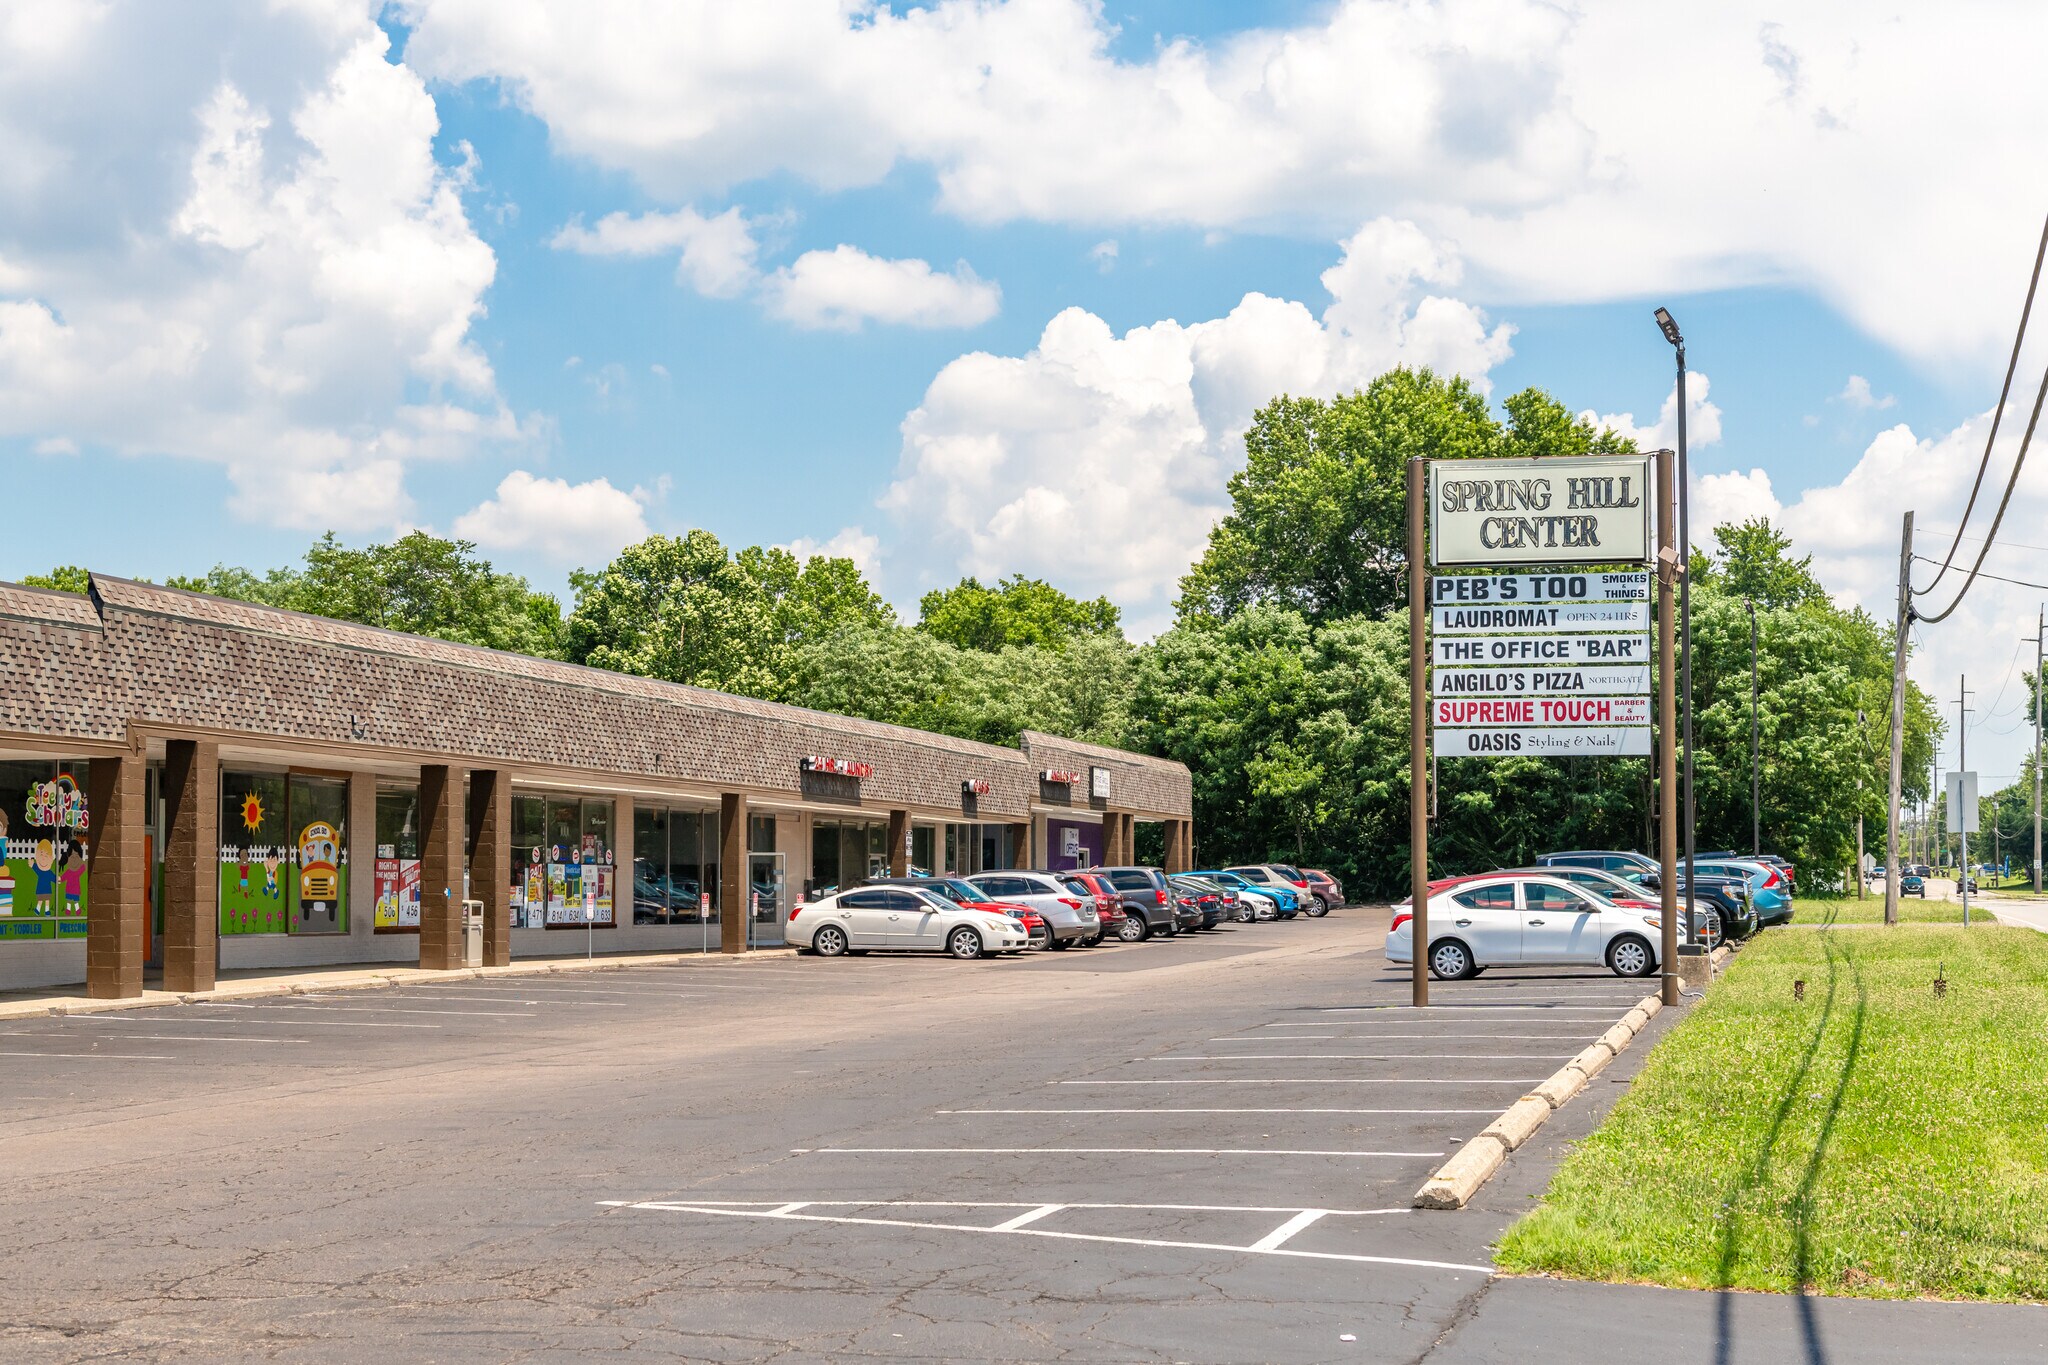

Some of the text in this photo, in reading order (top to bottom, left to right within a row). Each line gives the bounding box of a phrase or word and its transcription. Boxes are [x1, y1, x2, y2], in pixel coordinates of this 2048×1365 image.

[1442, 476, 1640, 513] SPRING HILL
[1479, 514, 1601, 550] CENTER
[1436, 576, 1587, 601] PEB'S TOO
[1601, 574, 1647, 584] SMOKES
[1604, 589, 1645, 599] THINGS
[1444, 608, 1638, 628] LAUDROMAT OPEN 24 HRS
[1440, 638, 1642, 660] THE OFFICE "BAR"
[1441, 672, 1644, 692] ANGILO'S PIZZA NORTHGATE
[1439, 700, 1611, 723] SUPREME TOUCH
[1468, 732, 1616, 752] OASIS Styling & Nails
[25, 796, 89, 828] Scholars
[376, 871, 384, 879] THE
[383, 871, 399, 881] MONEY
[378, 861, 392, 871] RIGHT
[406, 905, 418, 917] 456
[13, 923, 42, 935] TODDLER
[60, 922, 87, 933] PRESCHO
